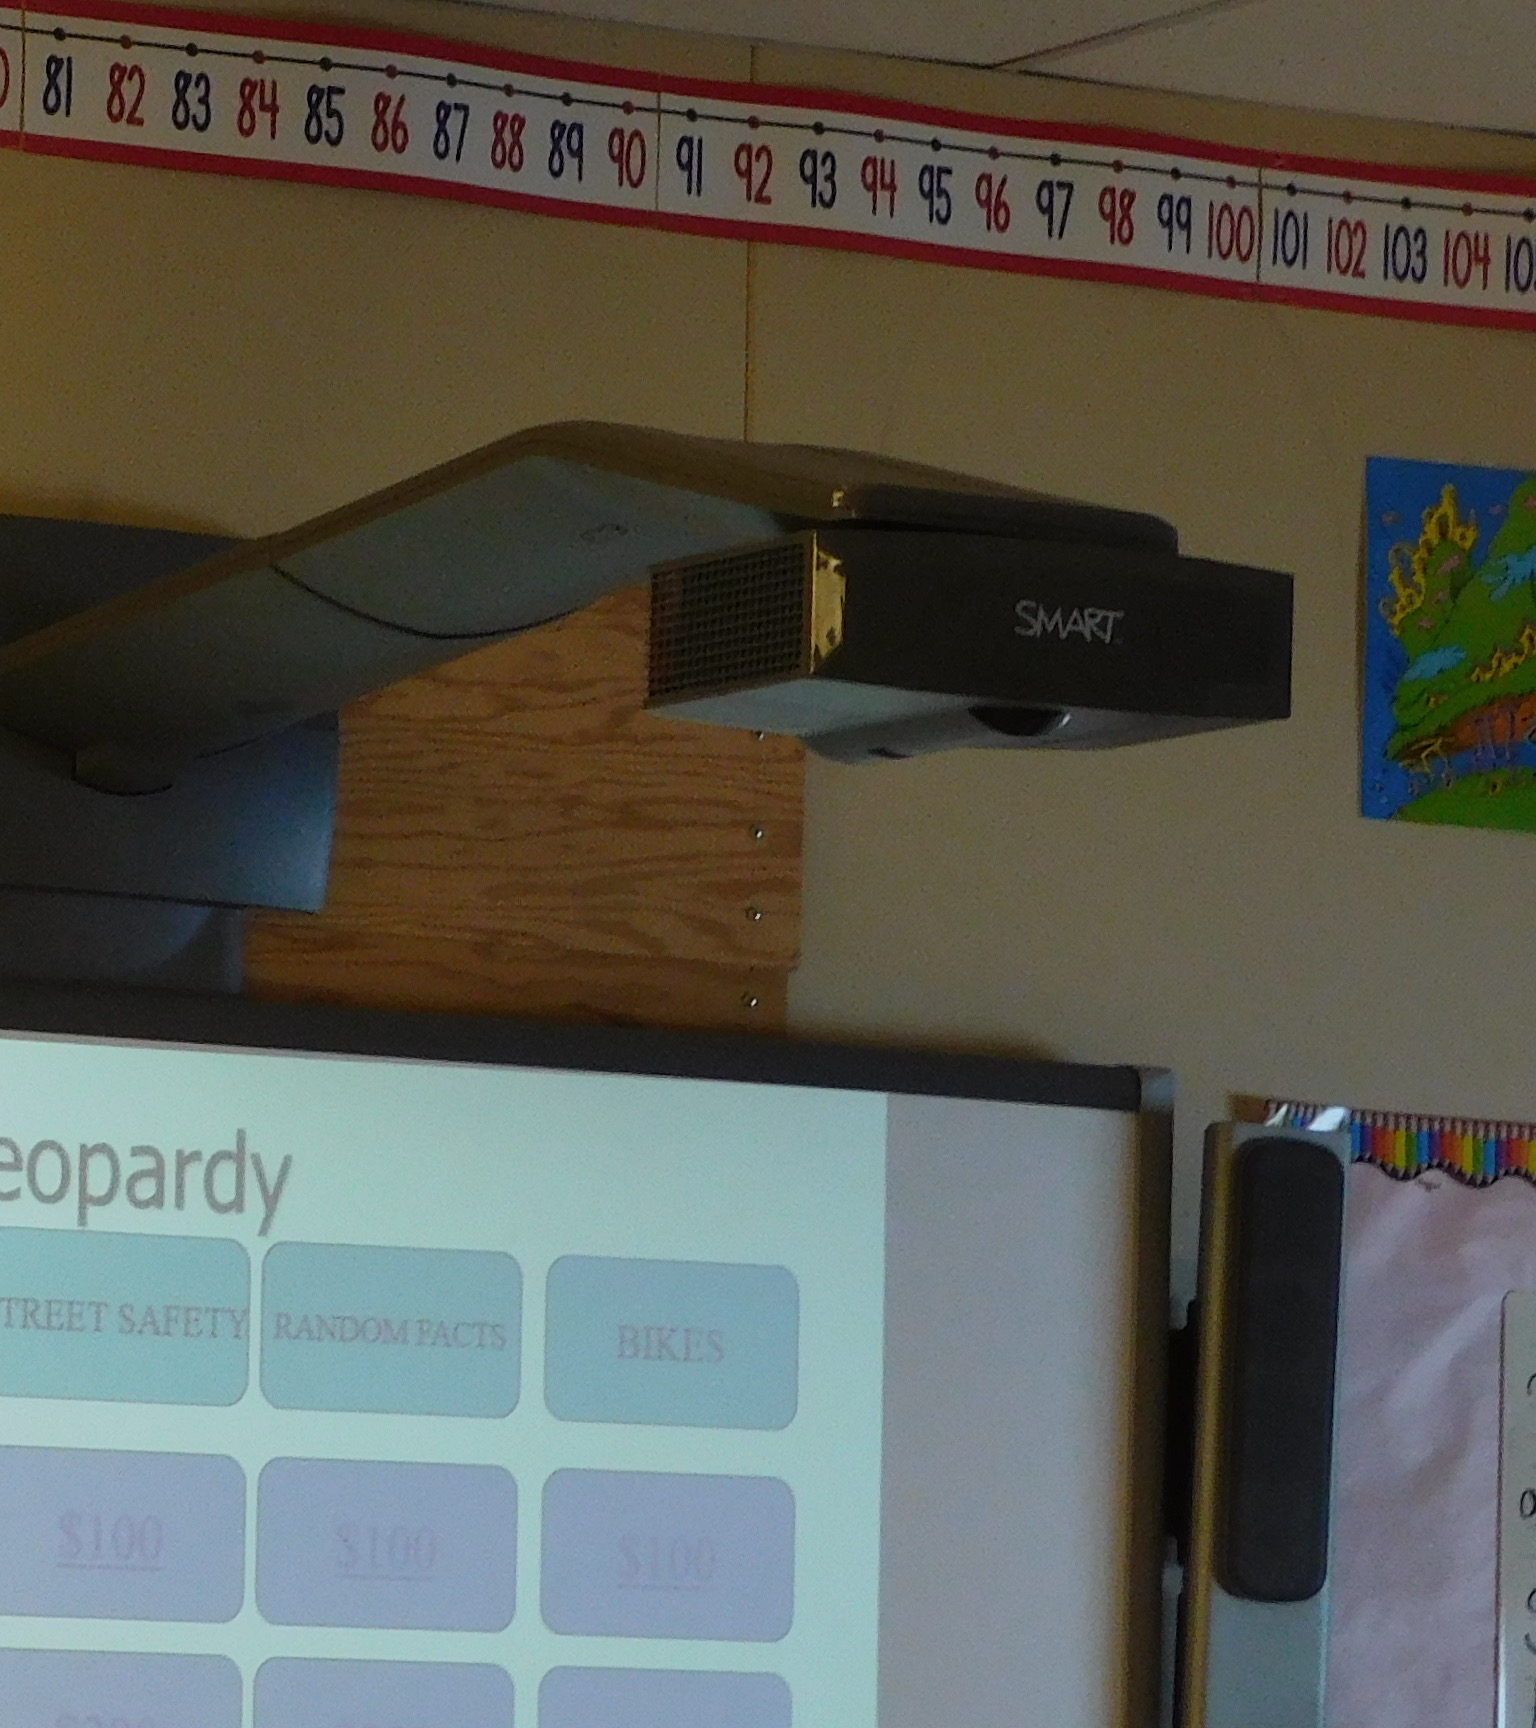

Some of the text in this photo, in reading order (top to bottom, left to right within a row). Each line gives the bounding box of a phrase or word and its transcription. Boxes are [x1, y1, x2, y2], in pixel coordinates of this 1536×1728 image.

[43, 55, 72, 117] 81
[107, 62, 145, 126] 82
[172, 70, 211, 132] 83
[237, 78, 279, 139] 84
[305, 84, 345, 146] 85
[371, 92, 408, 154] 86
[433, 101, 469, 162] 87
[491, 111, 526, 172] 88
[548, 120, 583, 181] 89
[608, 128, 646, 188] 90
[676, 136, 702, 196] 91
[734, 143, 773, 205] 92
[799, 149, 836, 209] 93
[861, 156, 897, 218] 94
[919, 164, 952, 225] 95
[975, 173, 1010, 233] 96
[1036, 180, 1074, 239] 97
[1098, 186, 1136, 245] 98
[1157, 193, 1191, 254] 99
[1208, 201, 1256, 262] 100
[1273, 208, 1308, 269] 101
[1327, 217, 1367, 279] 102
[1384, 224, 1427, 283] 103
[1444, 230, 1491, 290] 104
[1505, 235, 1534, 294] 10
[1014, 599, 1125, 643] SMART
[118, 1302, 250, 1342] SAFETY
[274, 1312, 507, 1351] RANDOM FACTS
[616, 1324, 725, 1366] BIKES
[57, 1511, 165, 1571] $100
